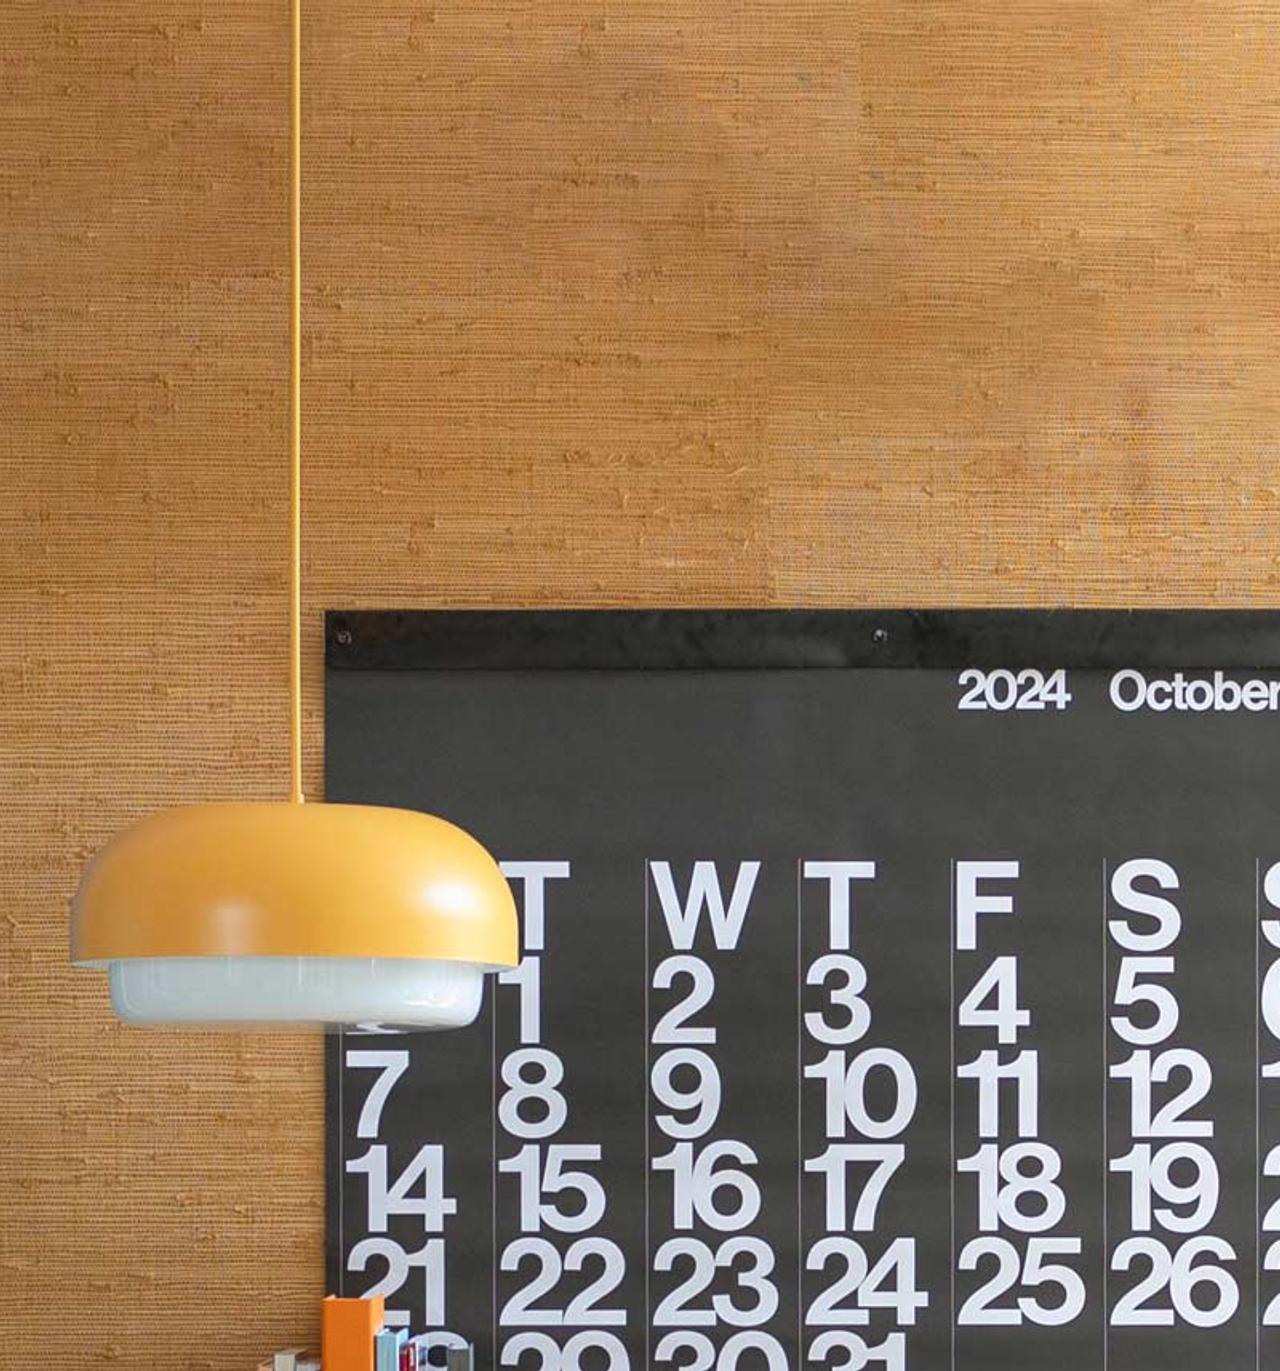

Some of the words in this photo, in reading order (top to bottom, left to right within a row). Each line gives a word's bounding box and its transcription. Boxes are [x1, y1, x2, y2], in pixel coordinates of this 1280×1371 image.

[958, 670, 1071, 711] 2024
[499, 861, 569, 949] T
[650, 861, 760, 949] W
[804, 861, 875, 949] T
[957, 861, 1019, 949] F
[1109, 859, 1181, 951] S
[499, 956, 540, 1043] 1
[652, 955, 716, 1043] 2
[805, 954, 871, 1044] 3
[959, 957, 1030, 1043] 4
[1111, 957, 1178, 1045] 5
[347, 1051, 409, 1137] 7
[499, 1048, 567, 1138] 8
[651, 1048, 720, 1138] 9
[804, 1048, 917, 1138] 10
[957, 1050, 1037, 1137] 11
[1110, 1049, 1213, 1137] 12
[346, 1145, 456, 1232] 14
[499, 1145, 605, 1232] 15
[652, 1140, 760, 1231] 16
[805, 1144, 904, 1231] 17
[957, 1142, 1065, 1232] 18
[1110, 1142, 1219, 1233] 19
[347, 1237, 445, 1325] 21
[500, 1237, 626, 1325] 22
[653, 1237, 778, 1326] 23
[805, 1237, 928, 1325] 24
[958, 1237, 1085, 1325] 25
[1111, 1236, 1239, 1327] 26
